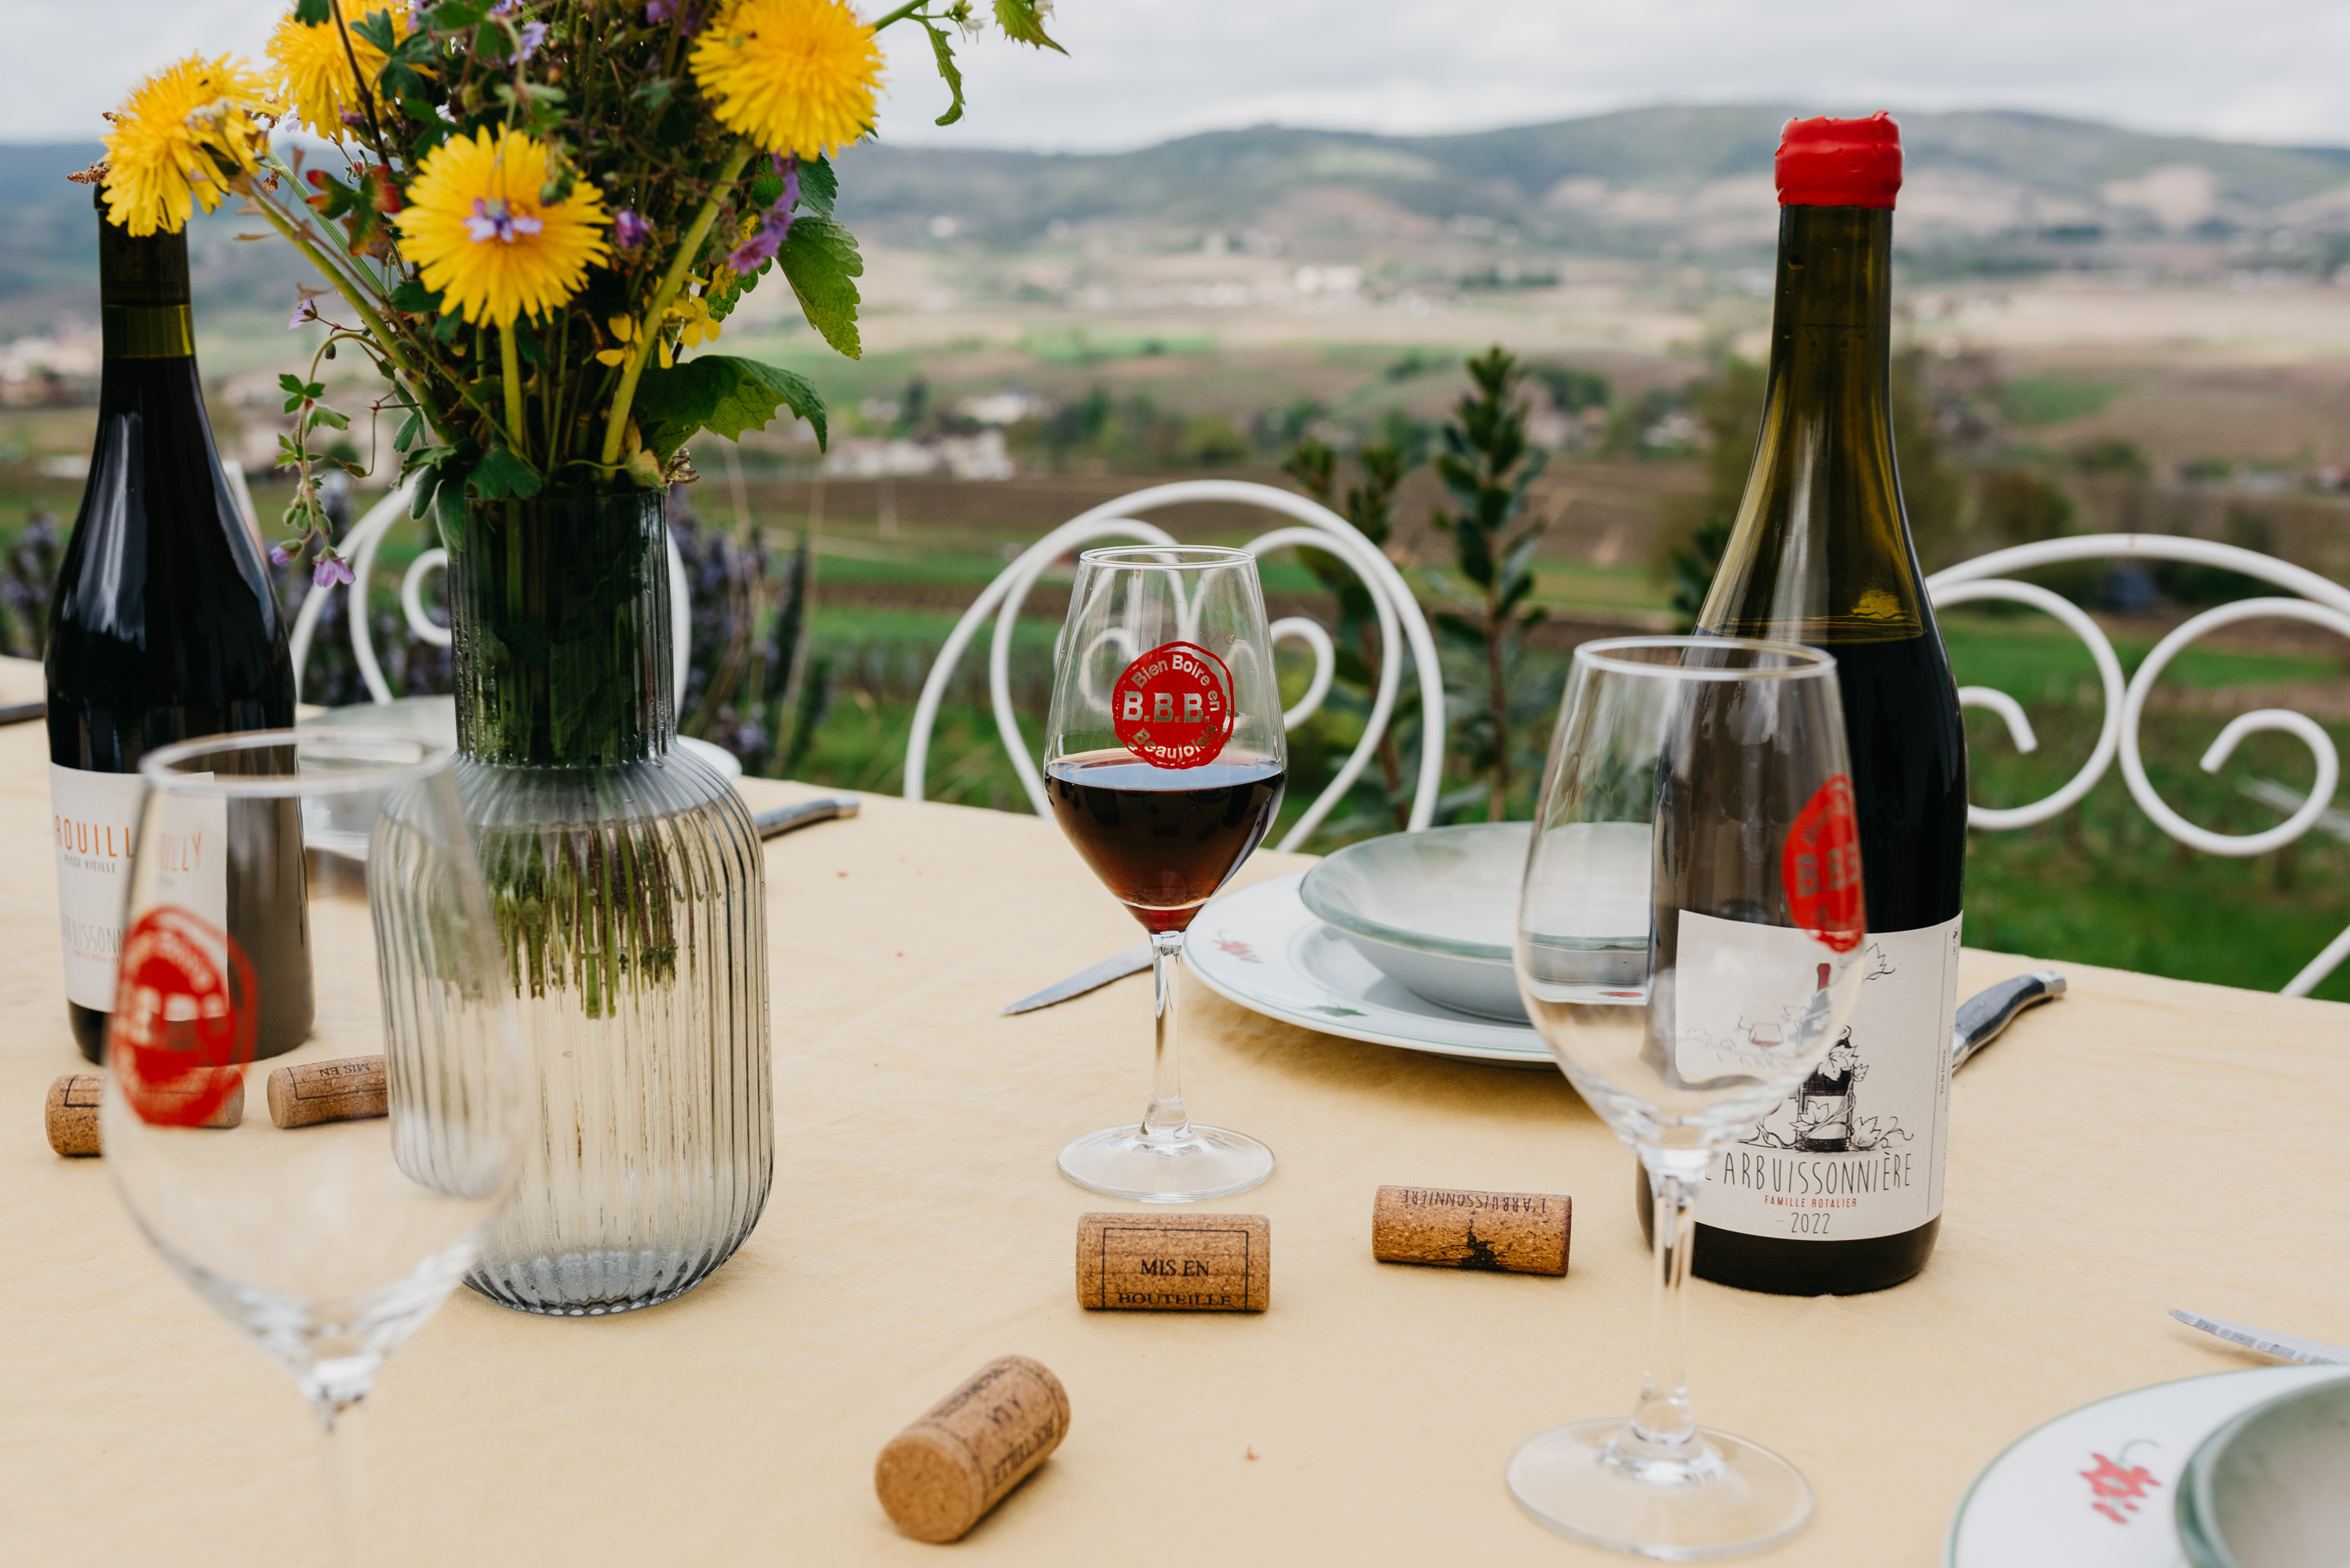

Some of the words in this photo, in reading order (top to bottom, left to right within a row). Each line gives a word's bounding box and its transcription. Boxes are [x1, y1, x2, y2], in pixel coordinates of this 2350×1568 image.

[1131, 660, 1169, 689] Bien
[1172, 654, 1210, 686] Boire
[1208, 690, 1221, 712] en
[1123, 690, 1210, 723] B.B.B.
[1133, 724, 1218, 763] Beaujolais
[319, 1066, 340, 1077] EN
[343, 1062, 371, 1073] MIS
[1764, 1195, 1806, 1207] FAMILLE
[1811, 1198, 1857, 1208] ROTALIER
[1791, 1212, 1831, 1234] 2022
[1141, 1258, 1177, 1277] MIS
[1183, 1260, 1210, 1278] EN
[1118, 1292, 1235, 1307] BOUTEILLE
